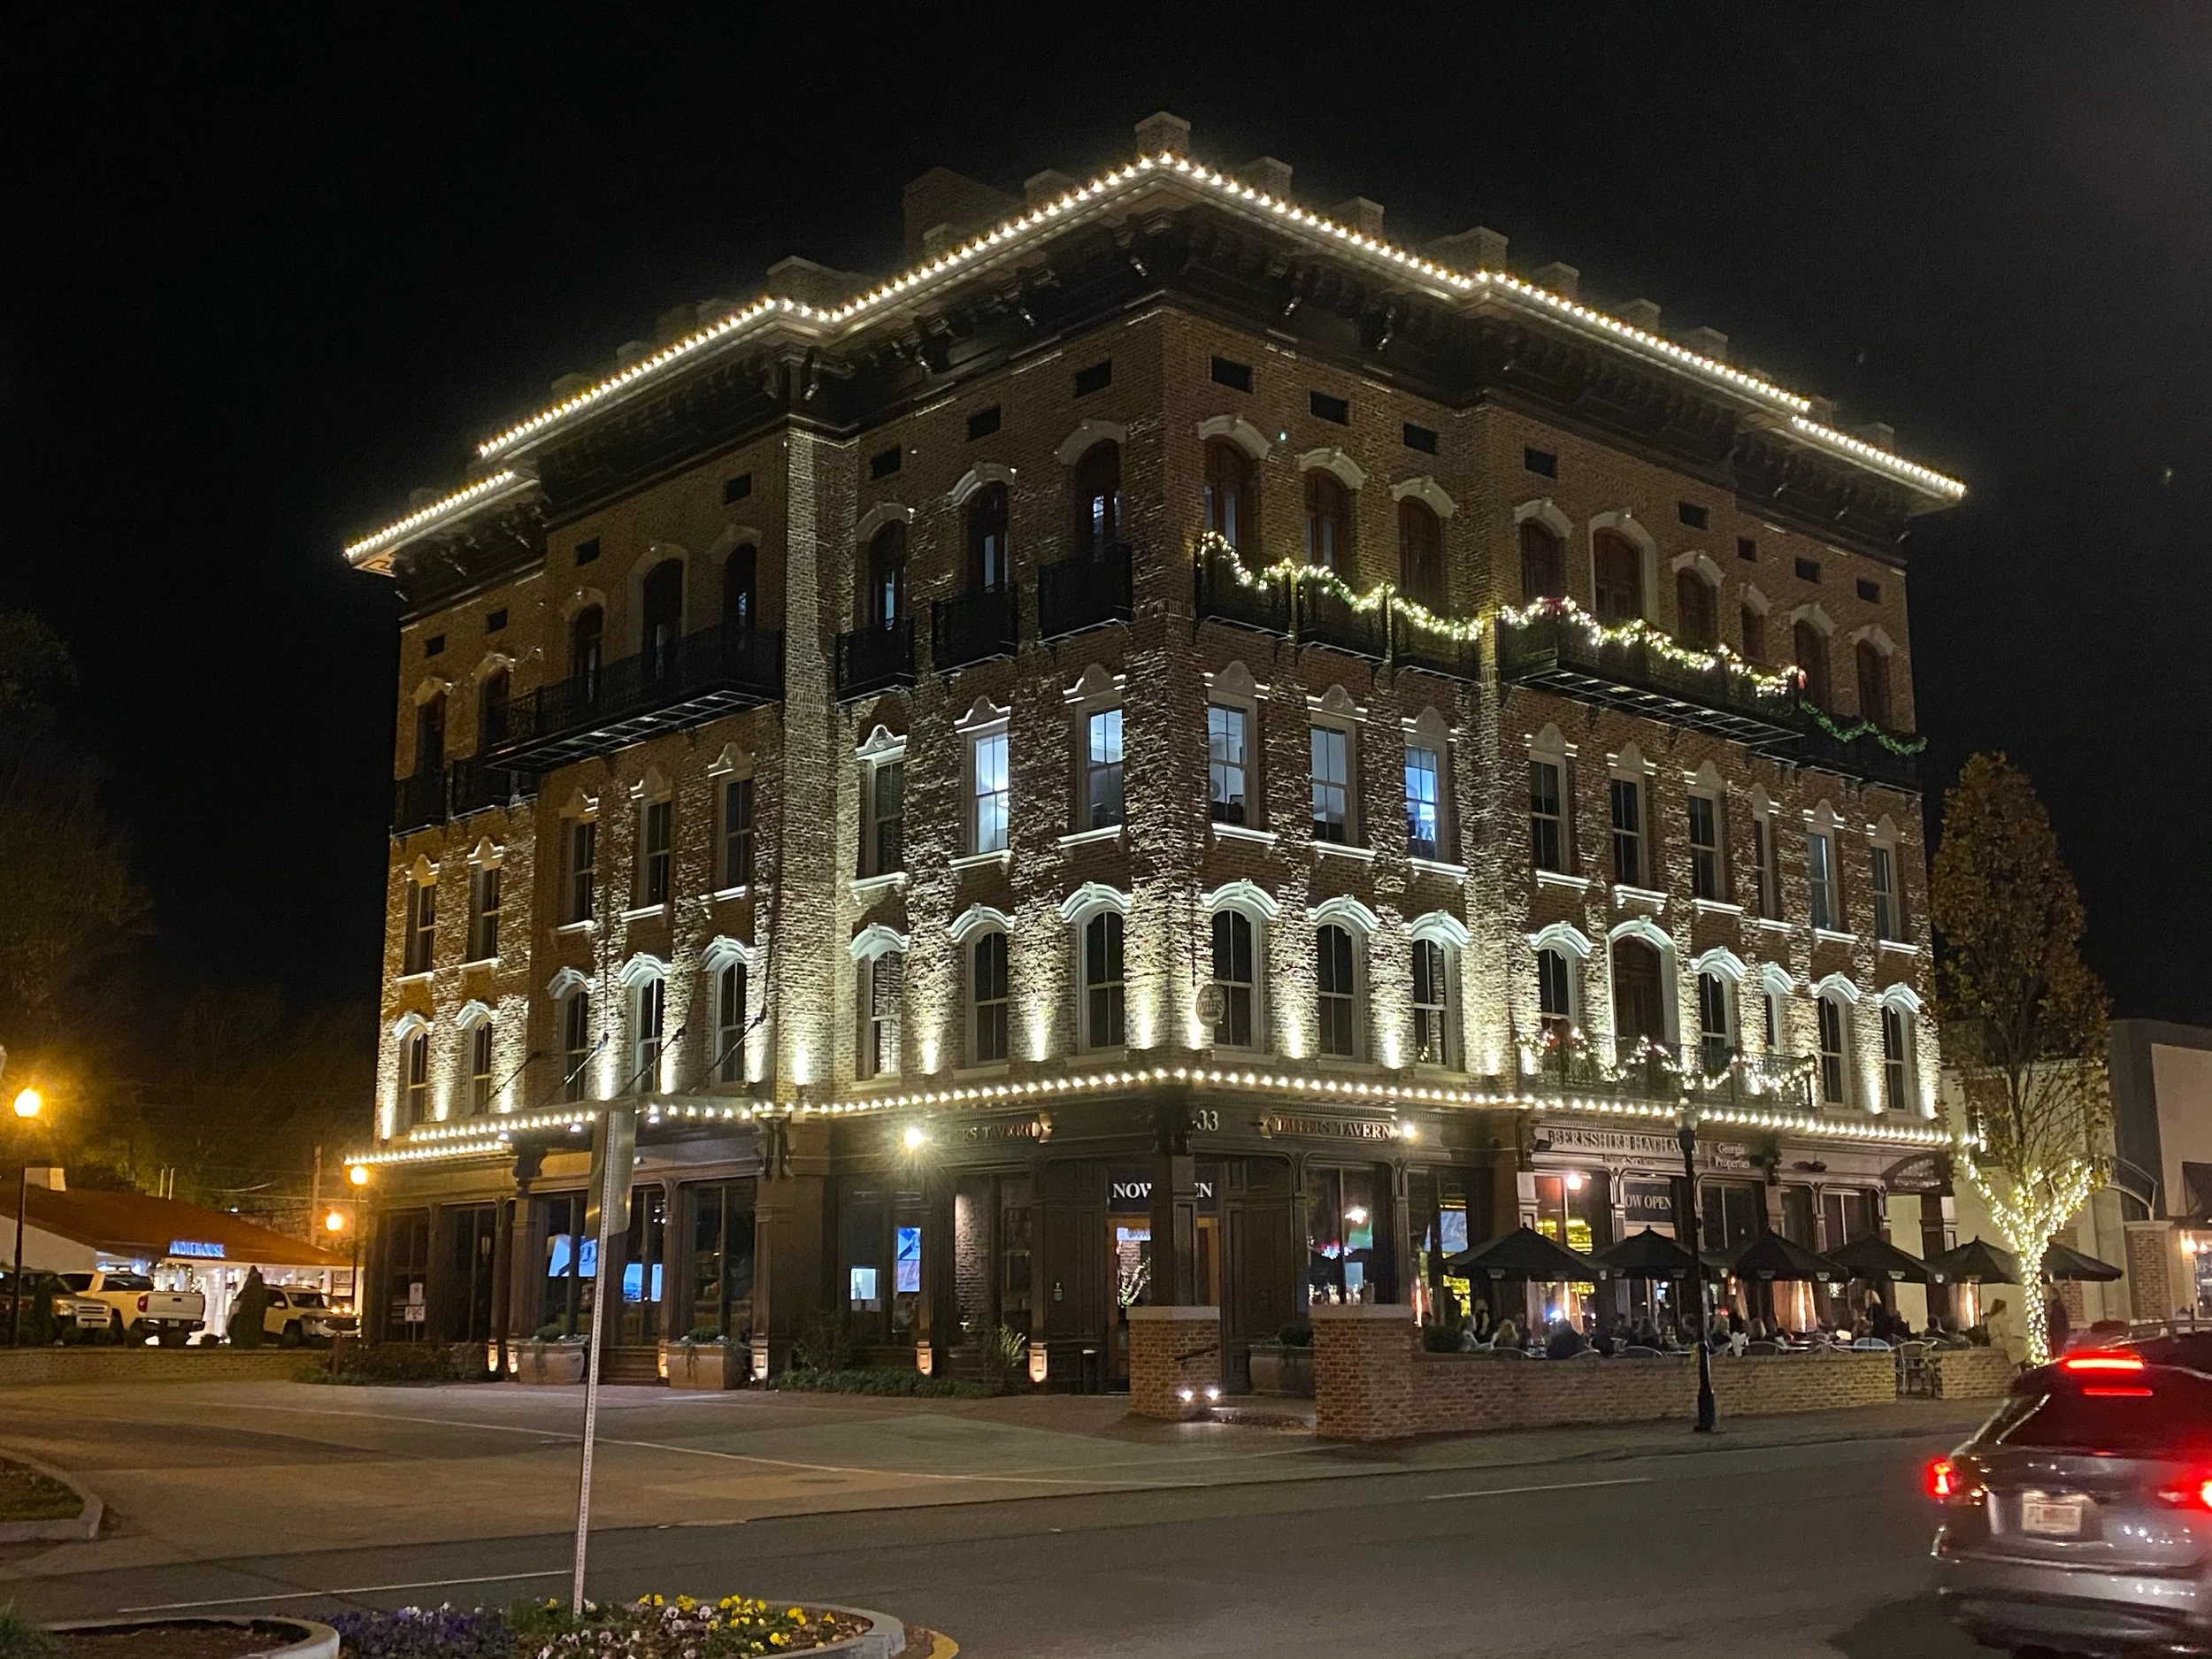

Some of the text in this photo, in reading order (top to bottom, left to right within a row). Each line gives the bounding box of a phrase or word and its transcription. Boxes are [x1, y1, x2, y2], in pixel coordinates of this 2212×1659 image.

[1336, 1122, 1393, 1140] TAVERN
[1549, 1131, 1701, 1155] BERKSHIRE HATHAY
[1717, 1141, 1746, 1157] Georgia
[1715, 1156, 1750, 1171] Properties
[1624, 1194, 1671, 1210] OW OPEN
